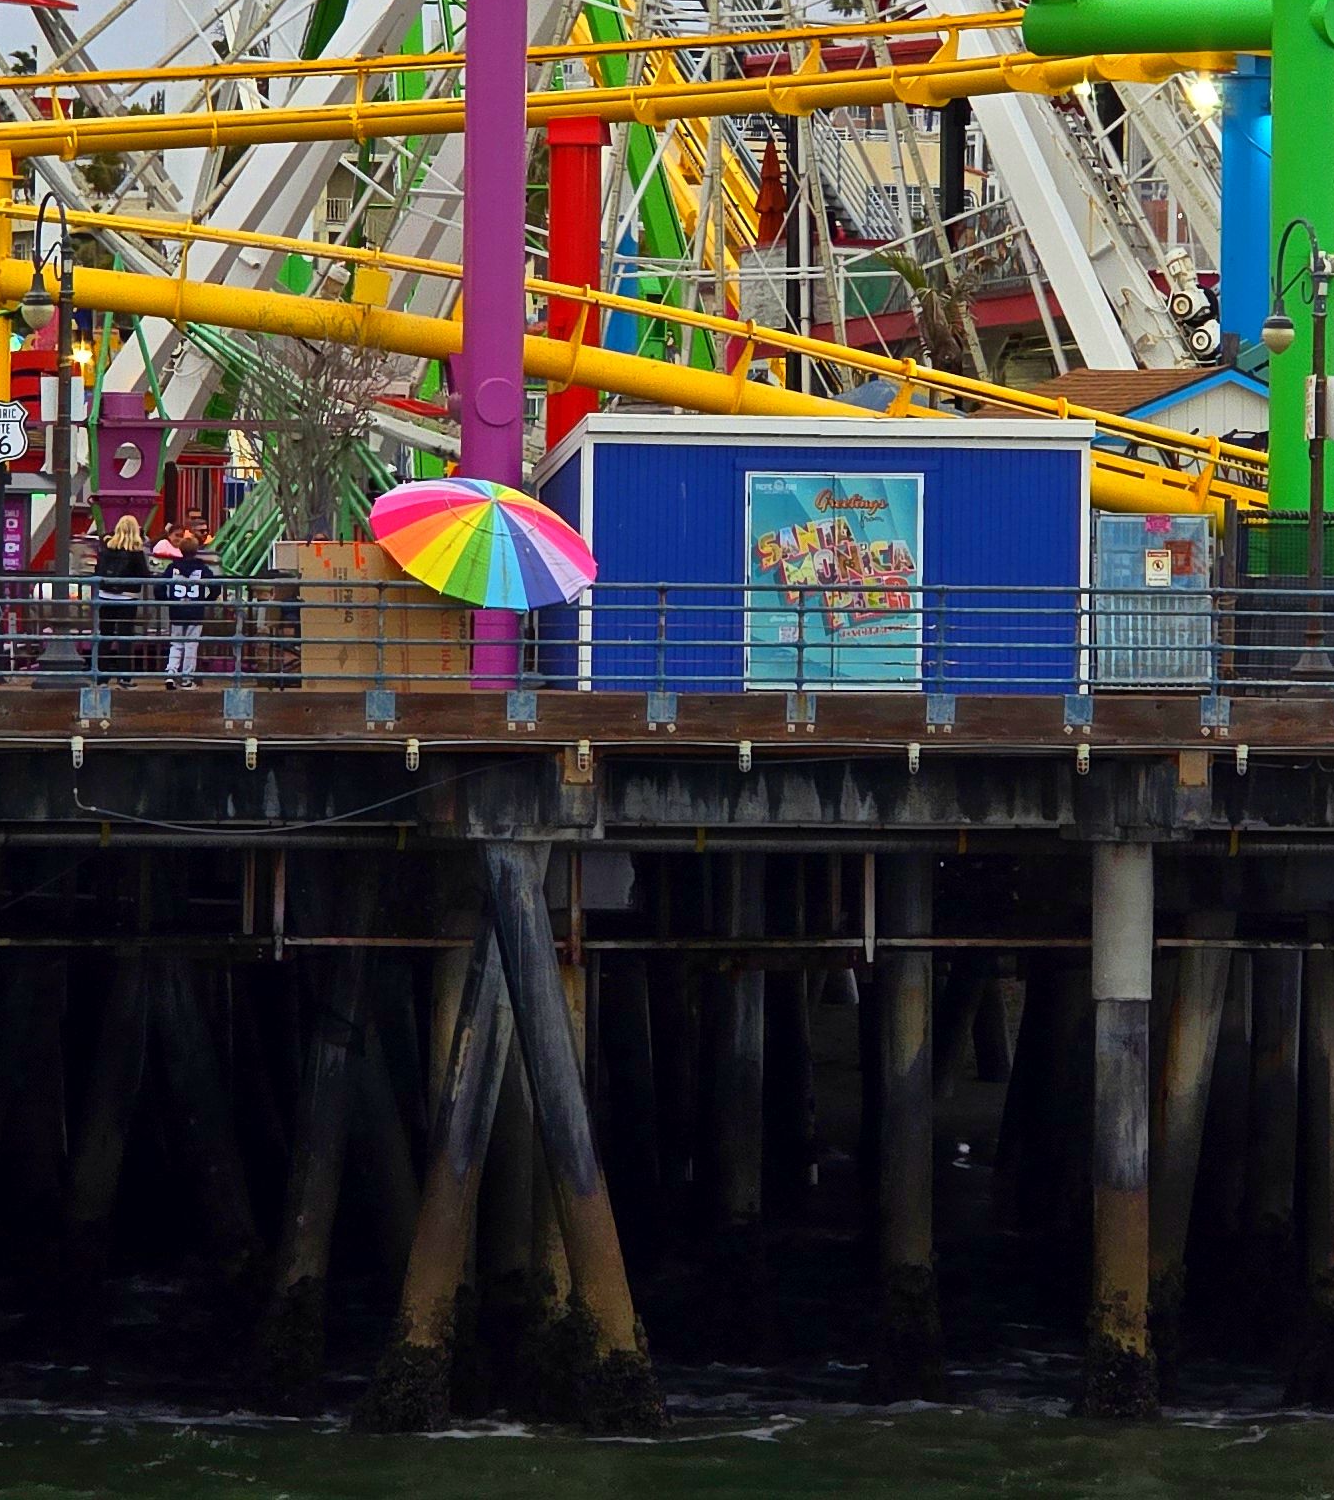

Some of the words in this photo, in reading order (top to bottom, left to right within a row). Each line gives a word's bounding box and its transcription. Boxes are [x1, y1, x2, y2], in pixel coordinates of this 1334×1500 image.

[814, 488, 889, 515] Greetings
[757, 515, 856, 570] SANTA
[781, 539, 917, 601] MONICA
[823, 574, 914, 628] PIER
